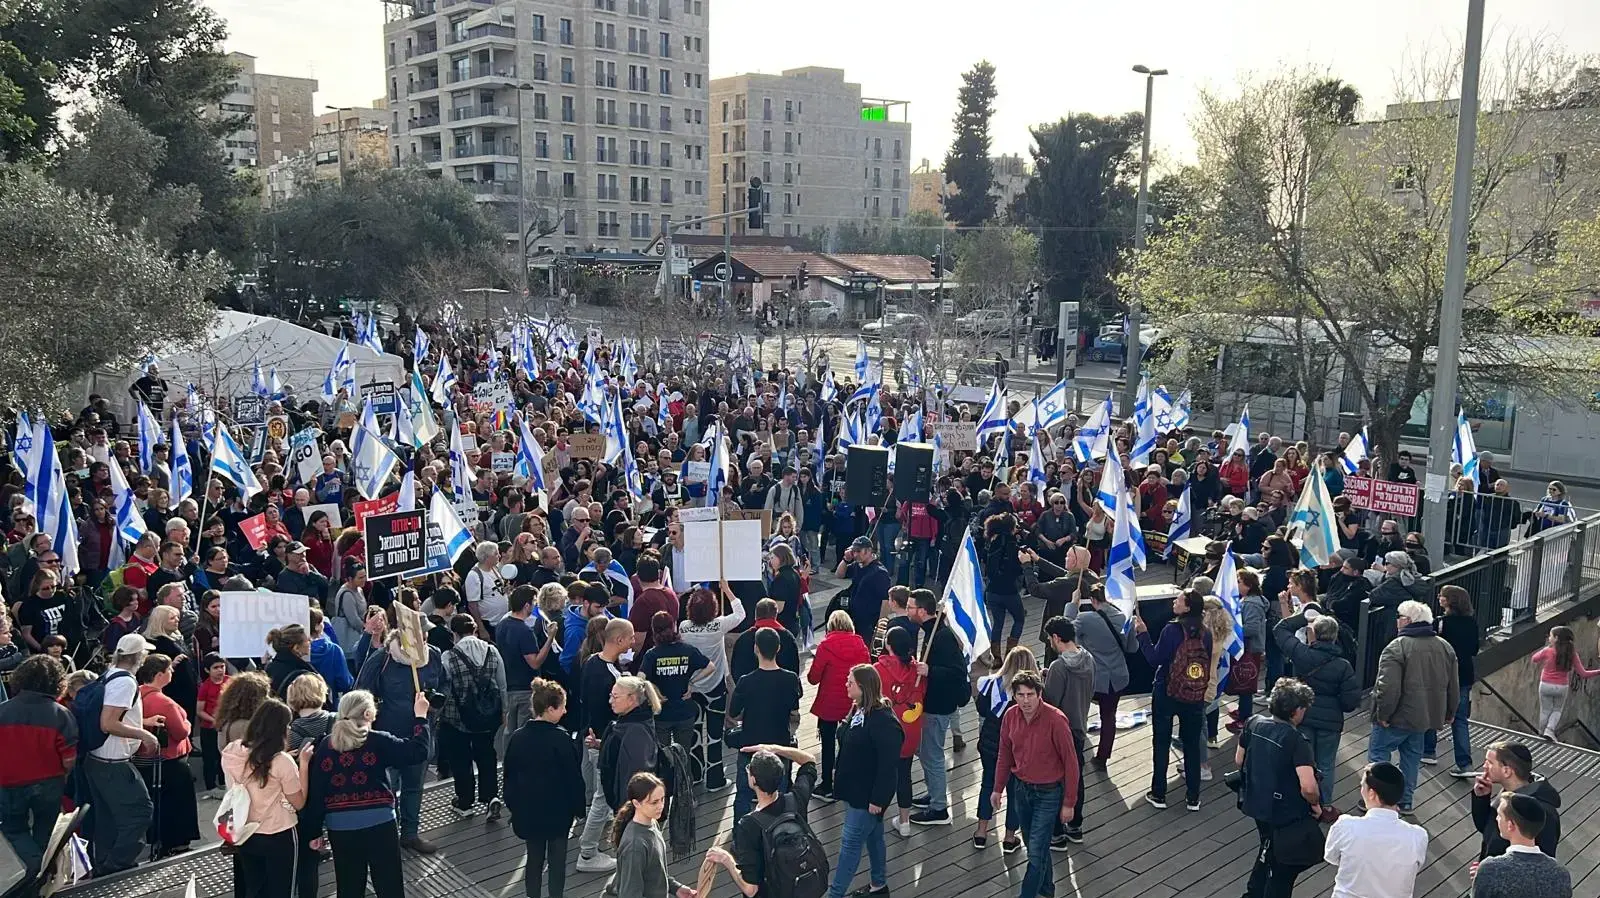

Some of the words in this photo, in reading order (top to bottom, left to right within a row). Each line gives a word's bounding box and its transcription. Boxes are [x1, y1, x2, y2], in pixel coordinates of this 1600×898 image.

[296, 445, 312, 462] GO
[1344, 478, 1369, 491] SICIANS
[1376, 482, 1416, 494] הרופאים
[1386, 492, 1393, 502] על
[1394, 494, 1414, 504] נלחמים
[1374, 500, 1413, 513] הדמוקרטיה
[379, 534, 404, 550] ושמאל
[406, 532, 419, 549] ימין
[388, 549, 408, 565] ההרס
[410, 547, 419, 560] נגד
[656, 666, 679, 676] אקדמיה
[680, 665, 689, 675] אין
